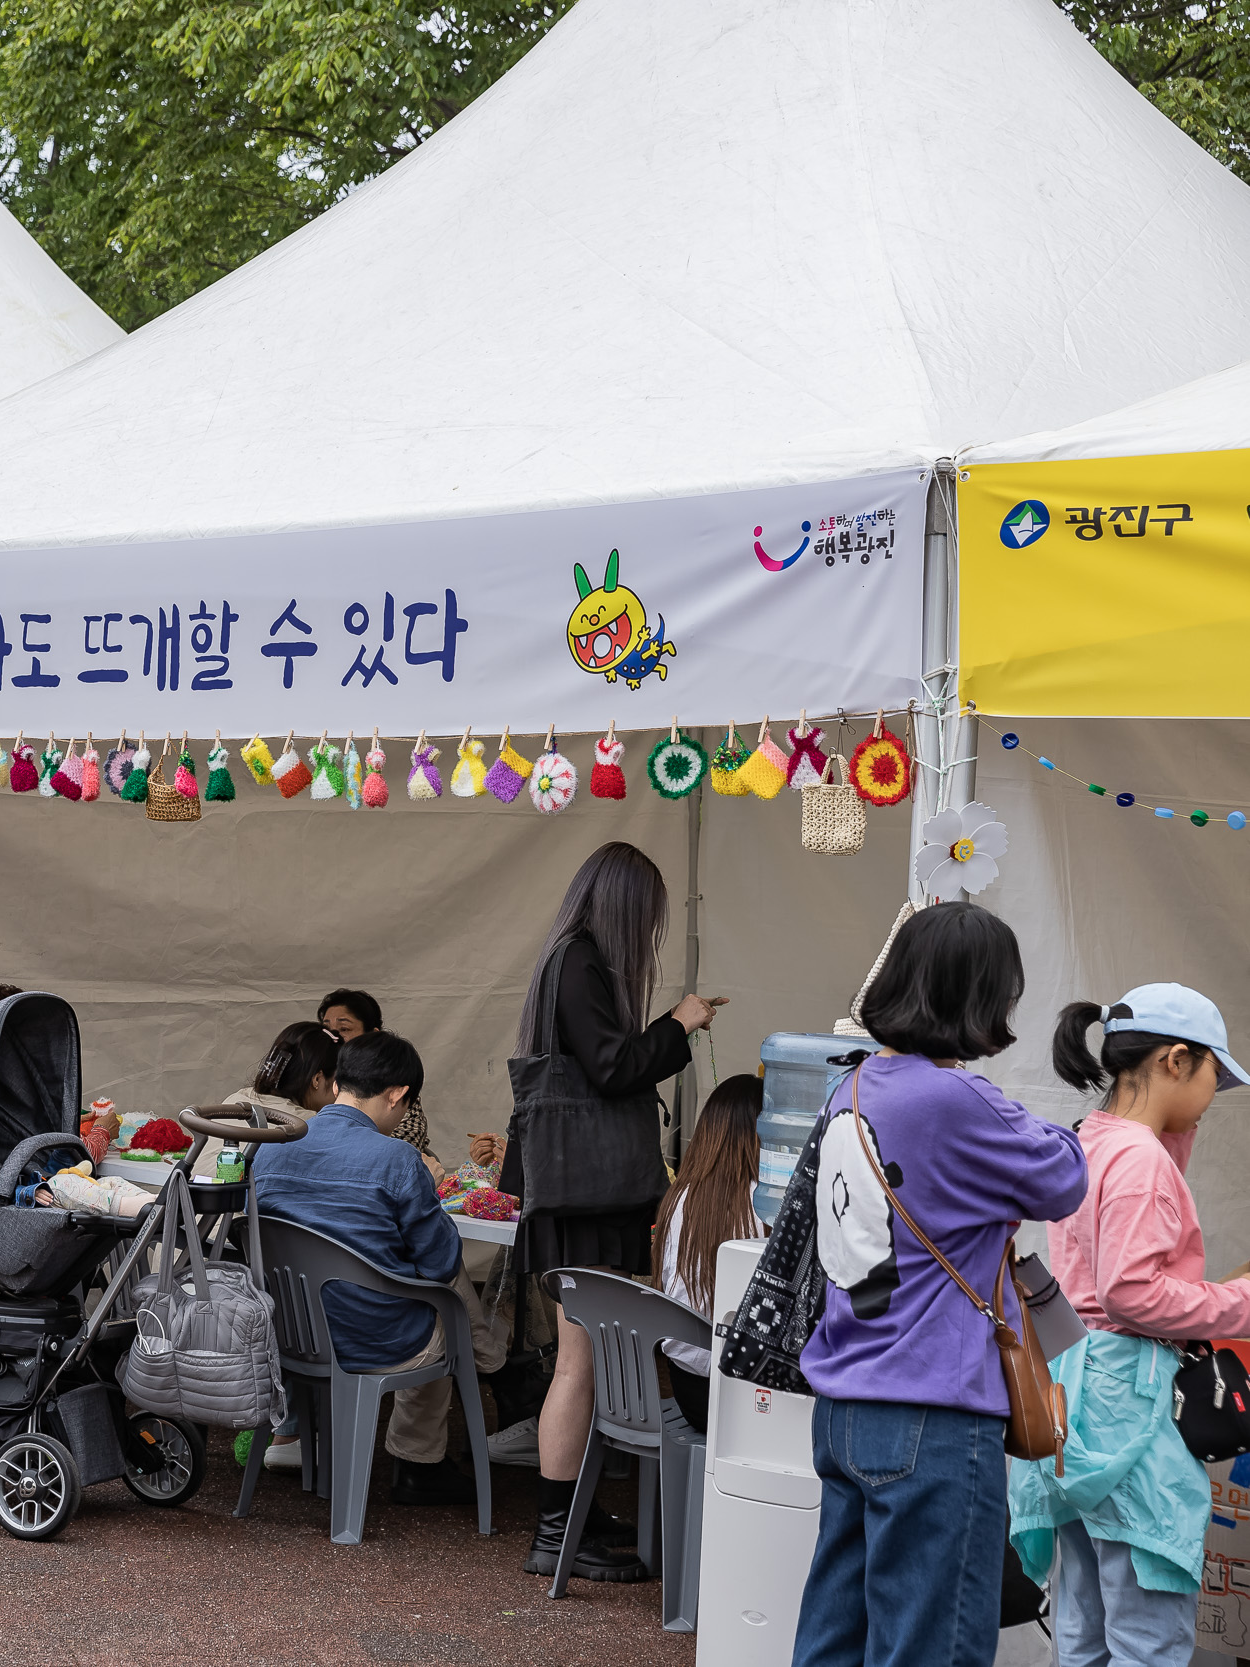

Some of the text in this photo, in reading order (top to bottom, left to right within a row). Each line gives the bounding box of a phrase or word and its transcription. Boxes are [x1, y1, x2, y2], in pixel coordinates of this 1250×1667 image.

[818, 509, 896, 536] 소통하며 발전하는
[1064, 503, 1194, 541] 광진구
[813, 529, 895, 567] 행복광진
[77, 599, 240, 691] 뜨개할
[260, 598, 319, 689] 수
[340, 588, 469, 688] 있다
